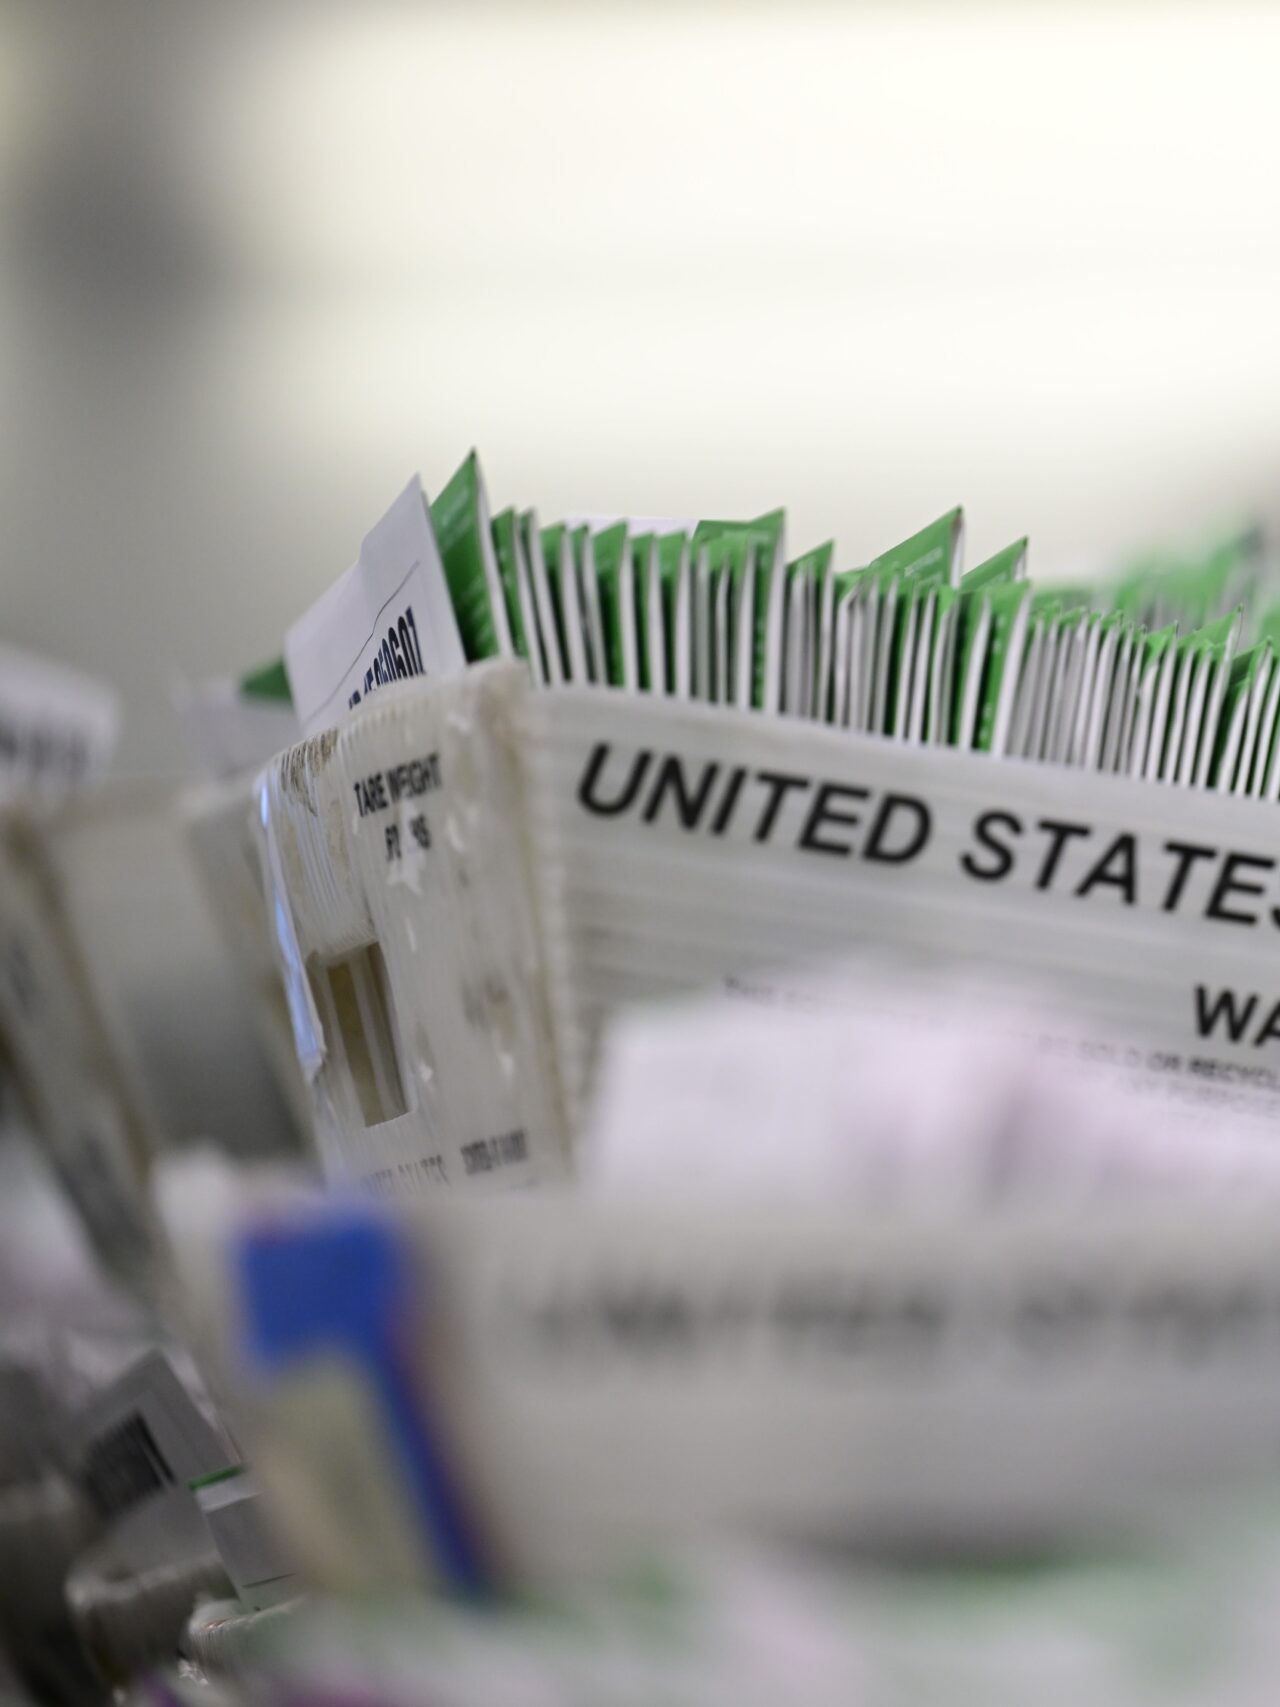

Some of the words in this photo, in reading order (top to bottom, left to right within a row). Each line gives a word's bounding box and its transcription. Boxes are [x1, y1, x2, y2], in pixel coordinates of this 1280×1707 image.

[354, 771, 389, 818] TARE
[577, 742, 934, 868] UNITED
[1146, 1051, 1180, 1073] OR
